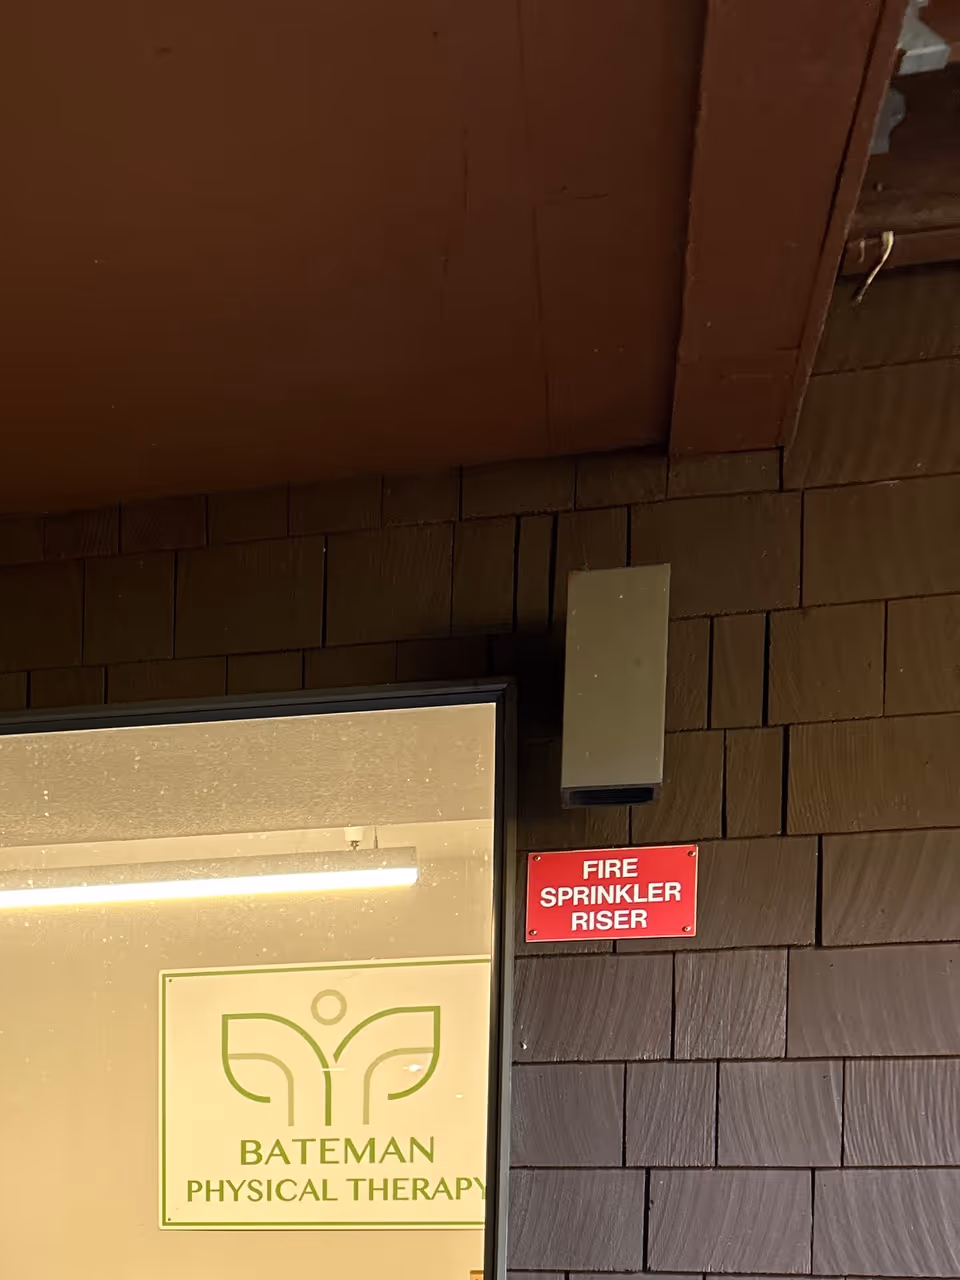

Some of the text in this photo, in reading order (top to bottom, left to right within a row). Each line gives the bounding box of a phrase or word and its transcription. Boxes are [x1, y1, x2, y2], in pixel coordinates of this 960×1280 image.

[583, 858, 638, 880] FIRE
[540, 881, 682, 908] SPRINKLER
[571, 909, 648, 931] RISER
[240, 1136, 434, 1165] BATEMAN
[187, 1178, 338, 1202] PHYSICAL
